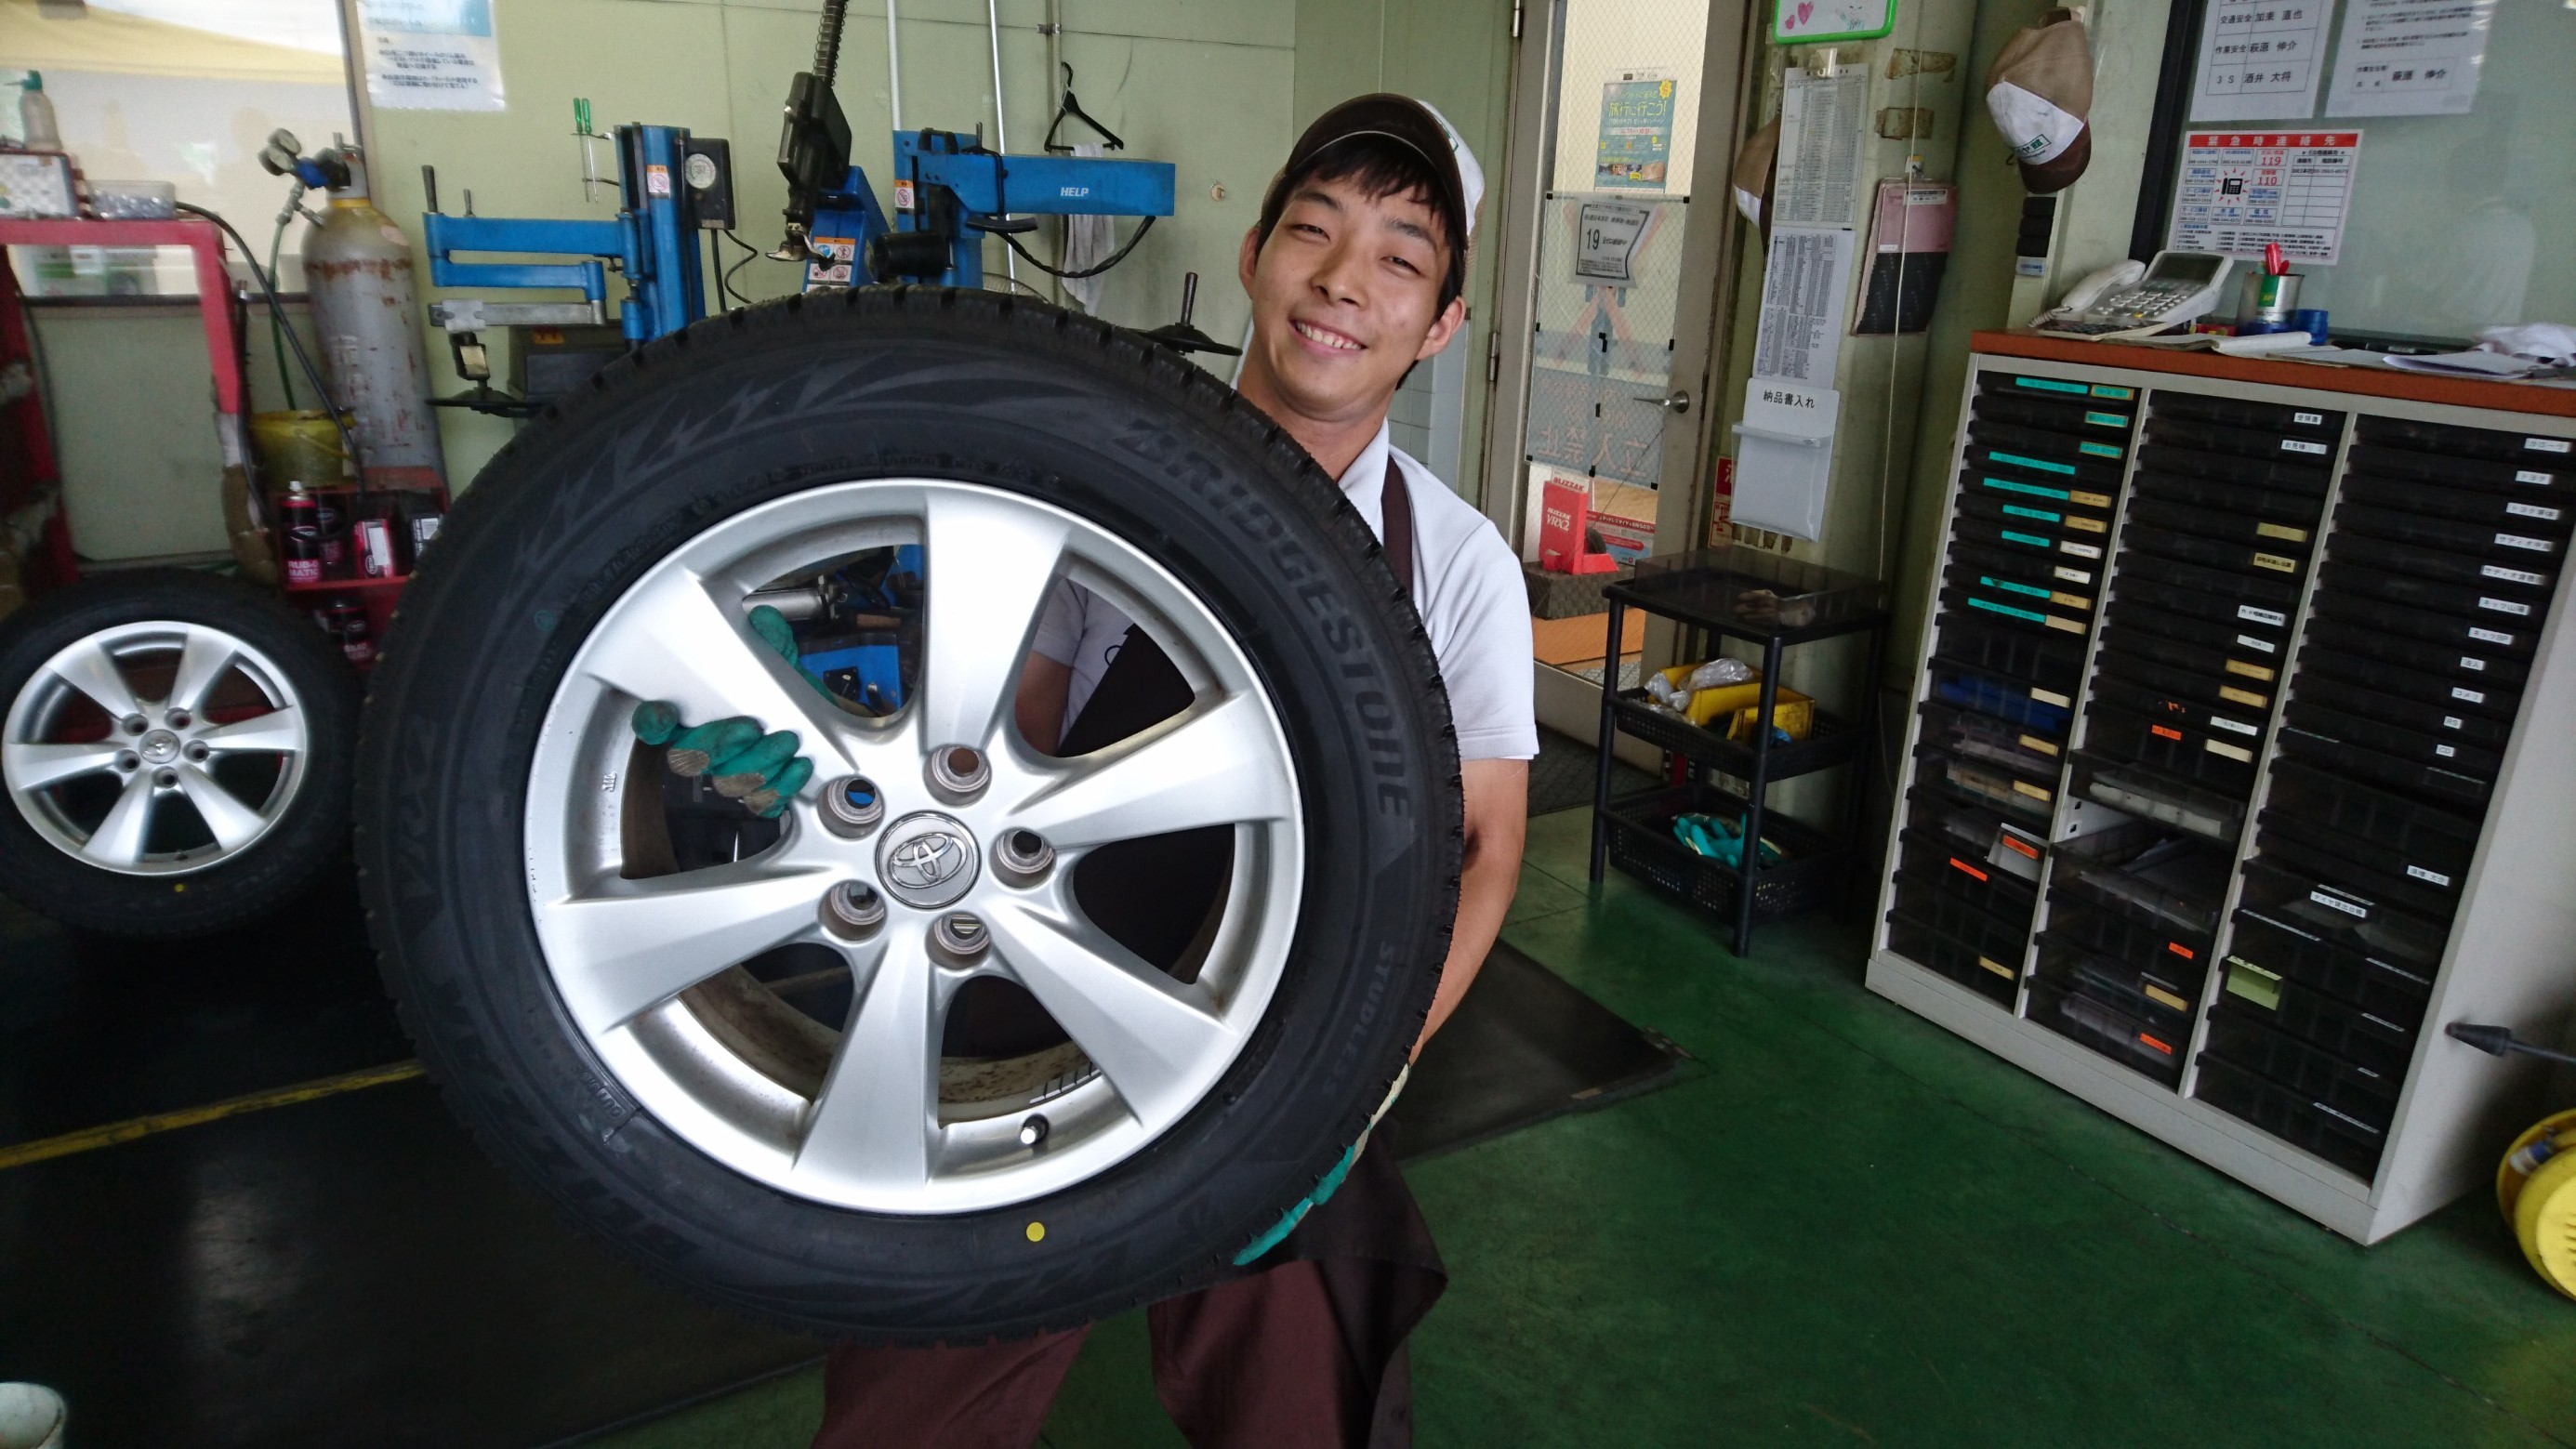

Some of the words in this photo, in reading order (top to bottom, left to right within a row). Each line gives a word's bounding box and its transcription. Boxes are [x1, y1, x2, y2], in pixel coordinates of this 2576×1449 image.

[2220, 14, 2252, 24] 交通安全
[2282, 8, 2303, 20] 直也
[2215, 45, 2246, 54] 作業安全
[2244, 72, 2264, 84] 酒井
[2270, 71, 2292, 82] 大将
[2208, 136, 2335, 147] 緊急時連絡先
[2261, 156, 2281, 166] 119
[2258, 176, 2278, 186] 110
[1060, 187, 1089, 197] HELP
[1586, 228, 1600, 250] 19
[1763, 390, 1815, 408] 納品書入れ
[2529, 441, 2564, 451] カローラ
[1552, 476, 1585, 492] BLIZZAK
[1547, 507, 1572, 520] BLIZZAK
[1546, 514, 1570, 533] VRX2
[1108, 412, 1420, 820] BRIDGESTONE
[2455, 690, 2478, 700] コメリ
[2446, 718, 2459, 726] RS
[2438, 746, 2451, 755] CD
[1314, 939, 1399, 1100] STUDLESS
